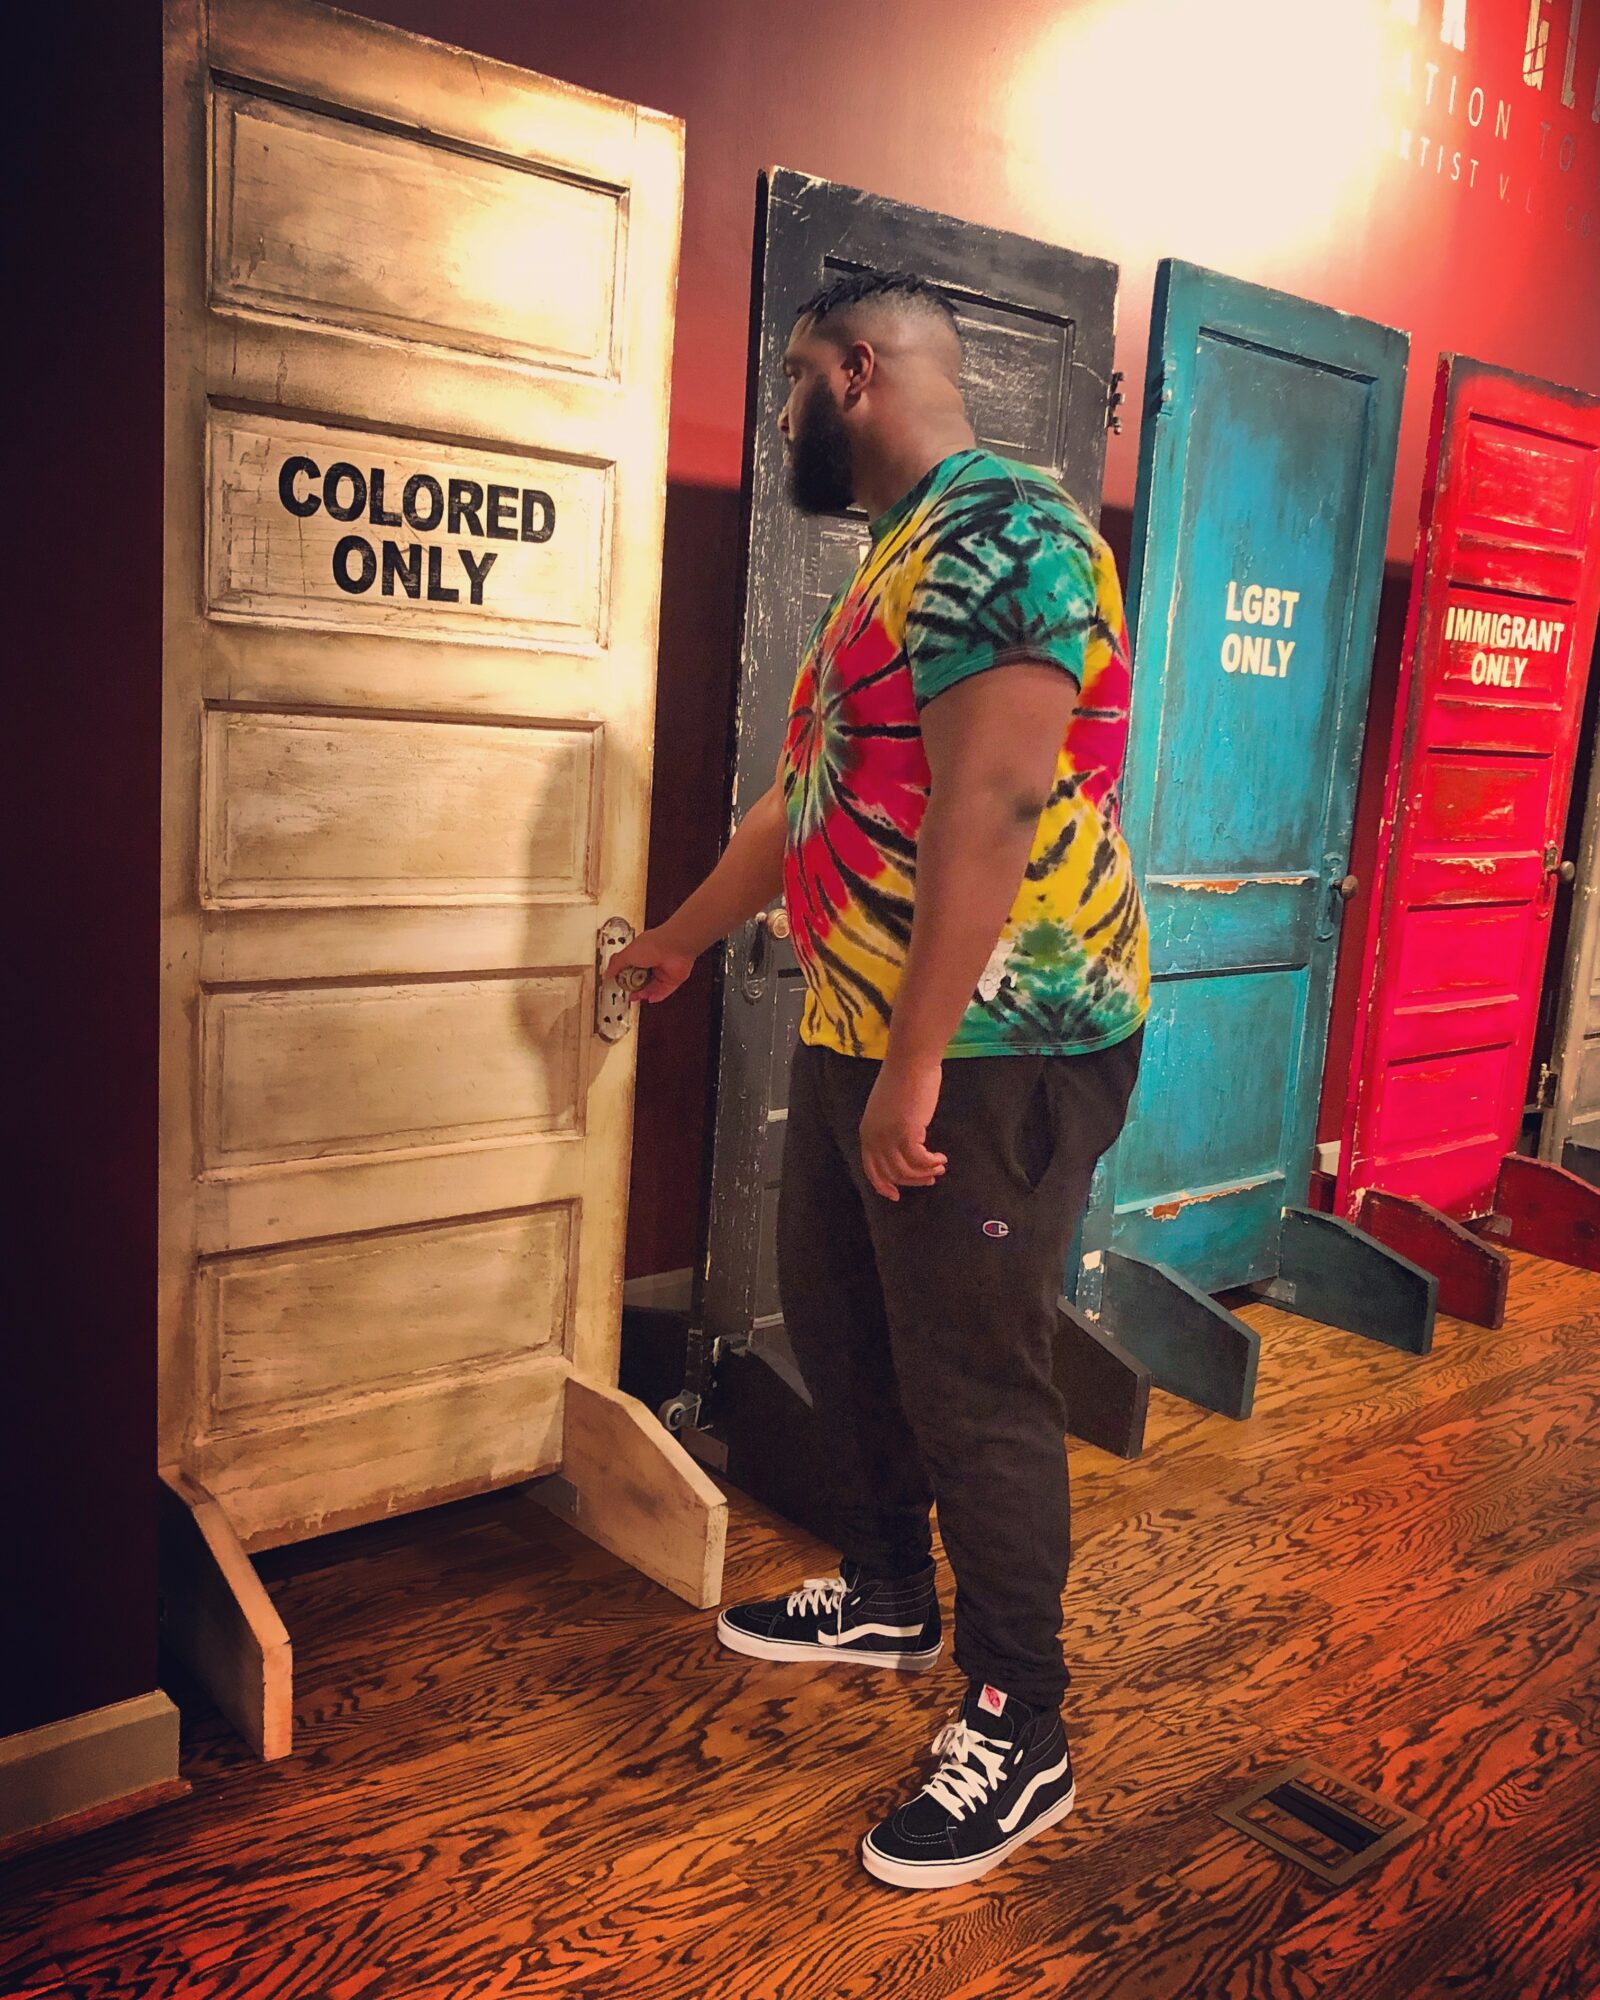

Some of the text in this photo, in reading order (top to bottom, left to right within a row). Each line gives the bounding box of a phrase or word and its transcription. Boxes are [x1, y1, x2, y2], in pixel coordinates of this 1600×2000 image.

[1401, 52, 1511, 140] TION
[1401, 131, 1479, 188] TIST
[278, 456, 555, 543] COLORED
[333, 535, 497, 605] ONLY
[1226, 581, 1300, 628] LGBT
[1445, 606, 1564, 655] IMMIGRANT
[1221, 633, 1296, 678] ONLY
[1470, 652, 1528, 688] ONLY
